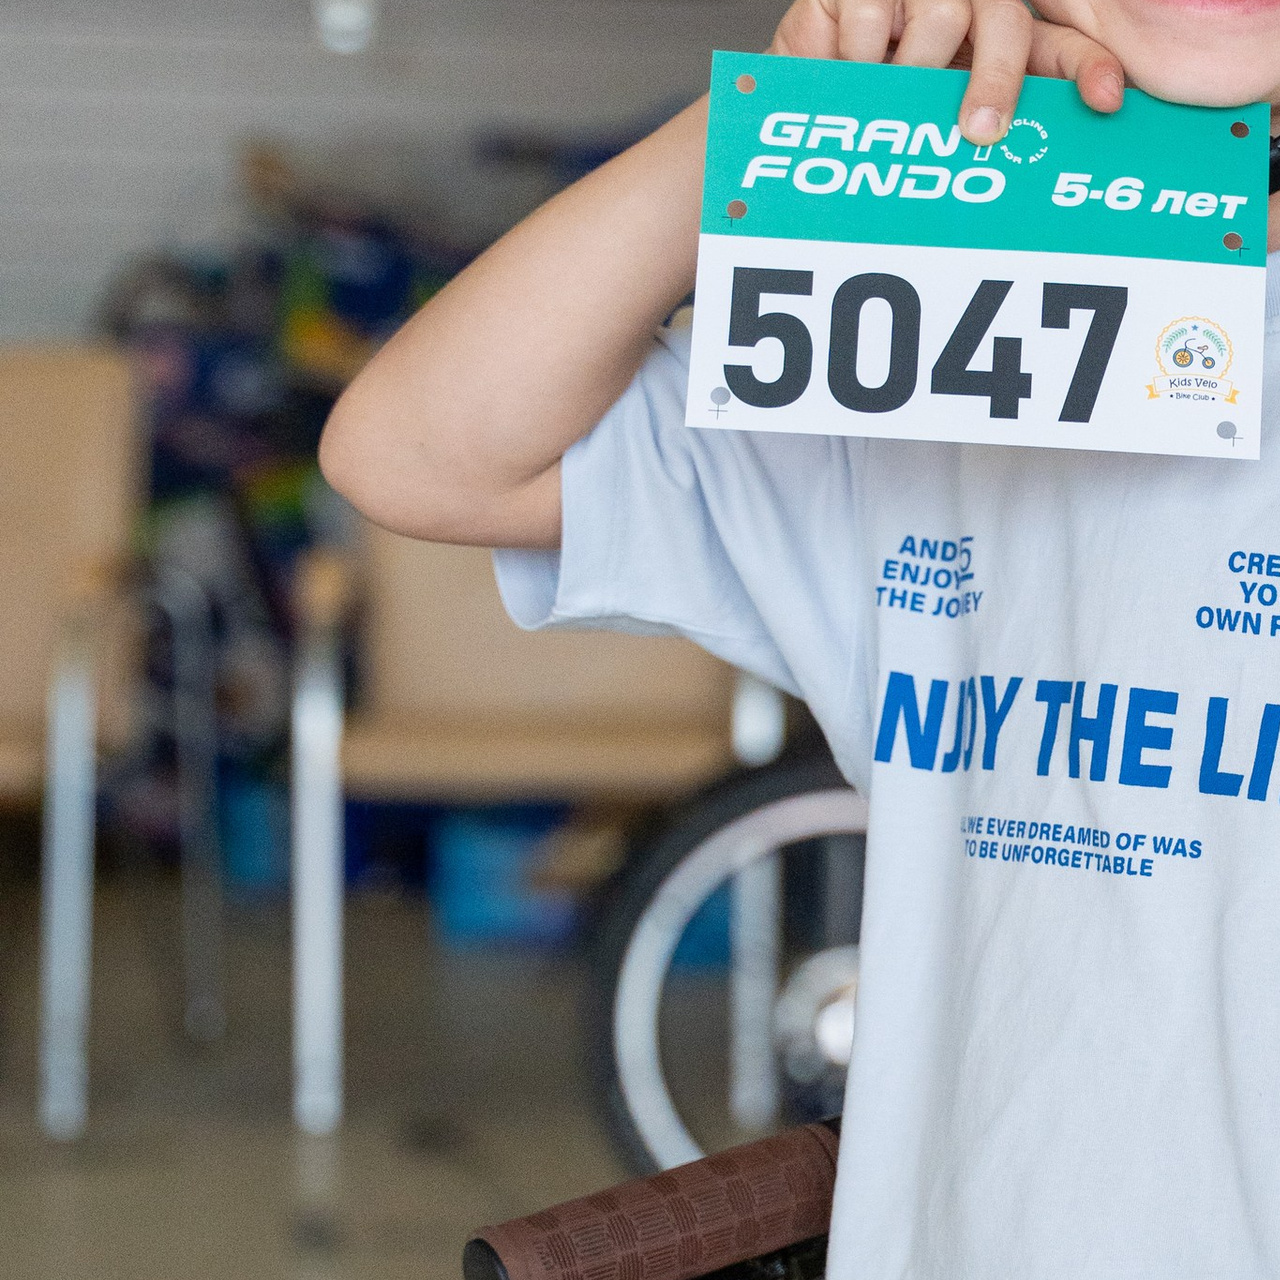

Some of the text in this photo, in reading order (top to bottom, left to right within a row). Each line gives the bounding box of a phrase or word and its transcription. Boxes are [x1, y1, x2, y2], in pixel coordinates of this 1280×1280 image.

[759, 111, 962, 157] GRAN
[1004, 118, 1048, 139] CLING
[1000, 144, 1048, 164] FOR ALL
[741, 155, 1006, 203] FONDO
[1051, 172, 1249, 219] 5-6 лет
[723, 266, 1129, 423] 5047
[1169, 377, 1218, 389] Kids Velo
[1175, 392, 1210, 401] Bike Club
[876, 586, 926, 613] THE
[1196, 606, 1262, 635] OWN
[1035, 680, 1179, 788] THE
[986, 817, 1027, 839] EVER
[1028, 821, 1111, 849] DREAMED
[1116, 832, 1147, 852] OF
[1153, 836, 1203, 859] WAS
[978, 840, 999, 859] BE
[1001, 844, 1154, 877] UNFORGETTABLE
